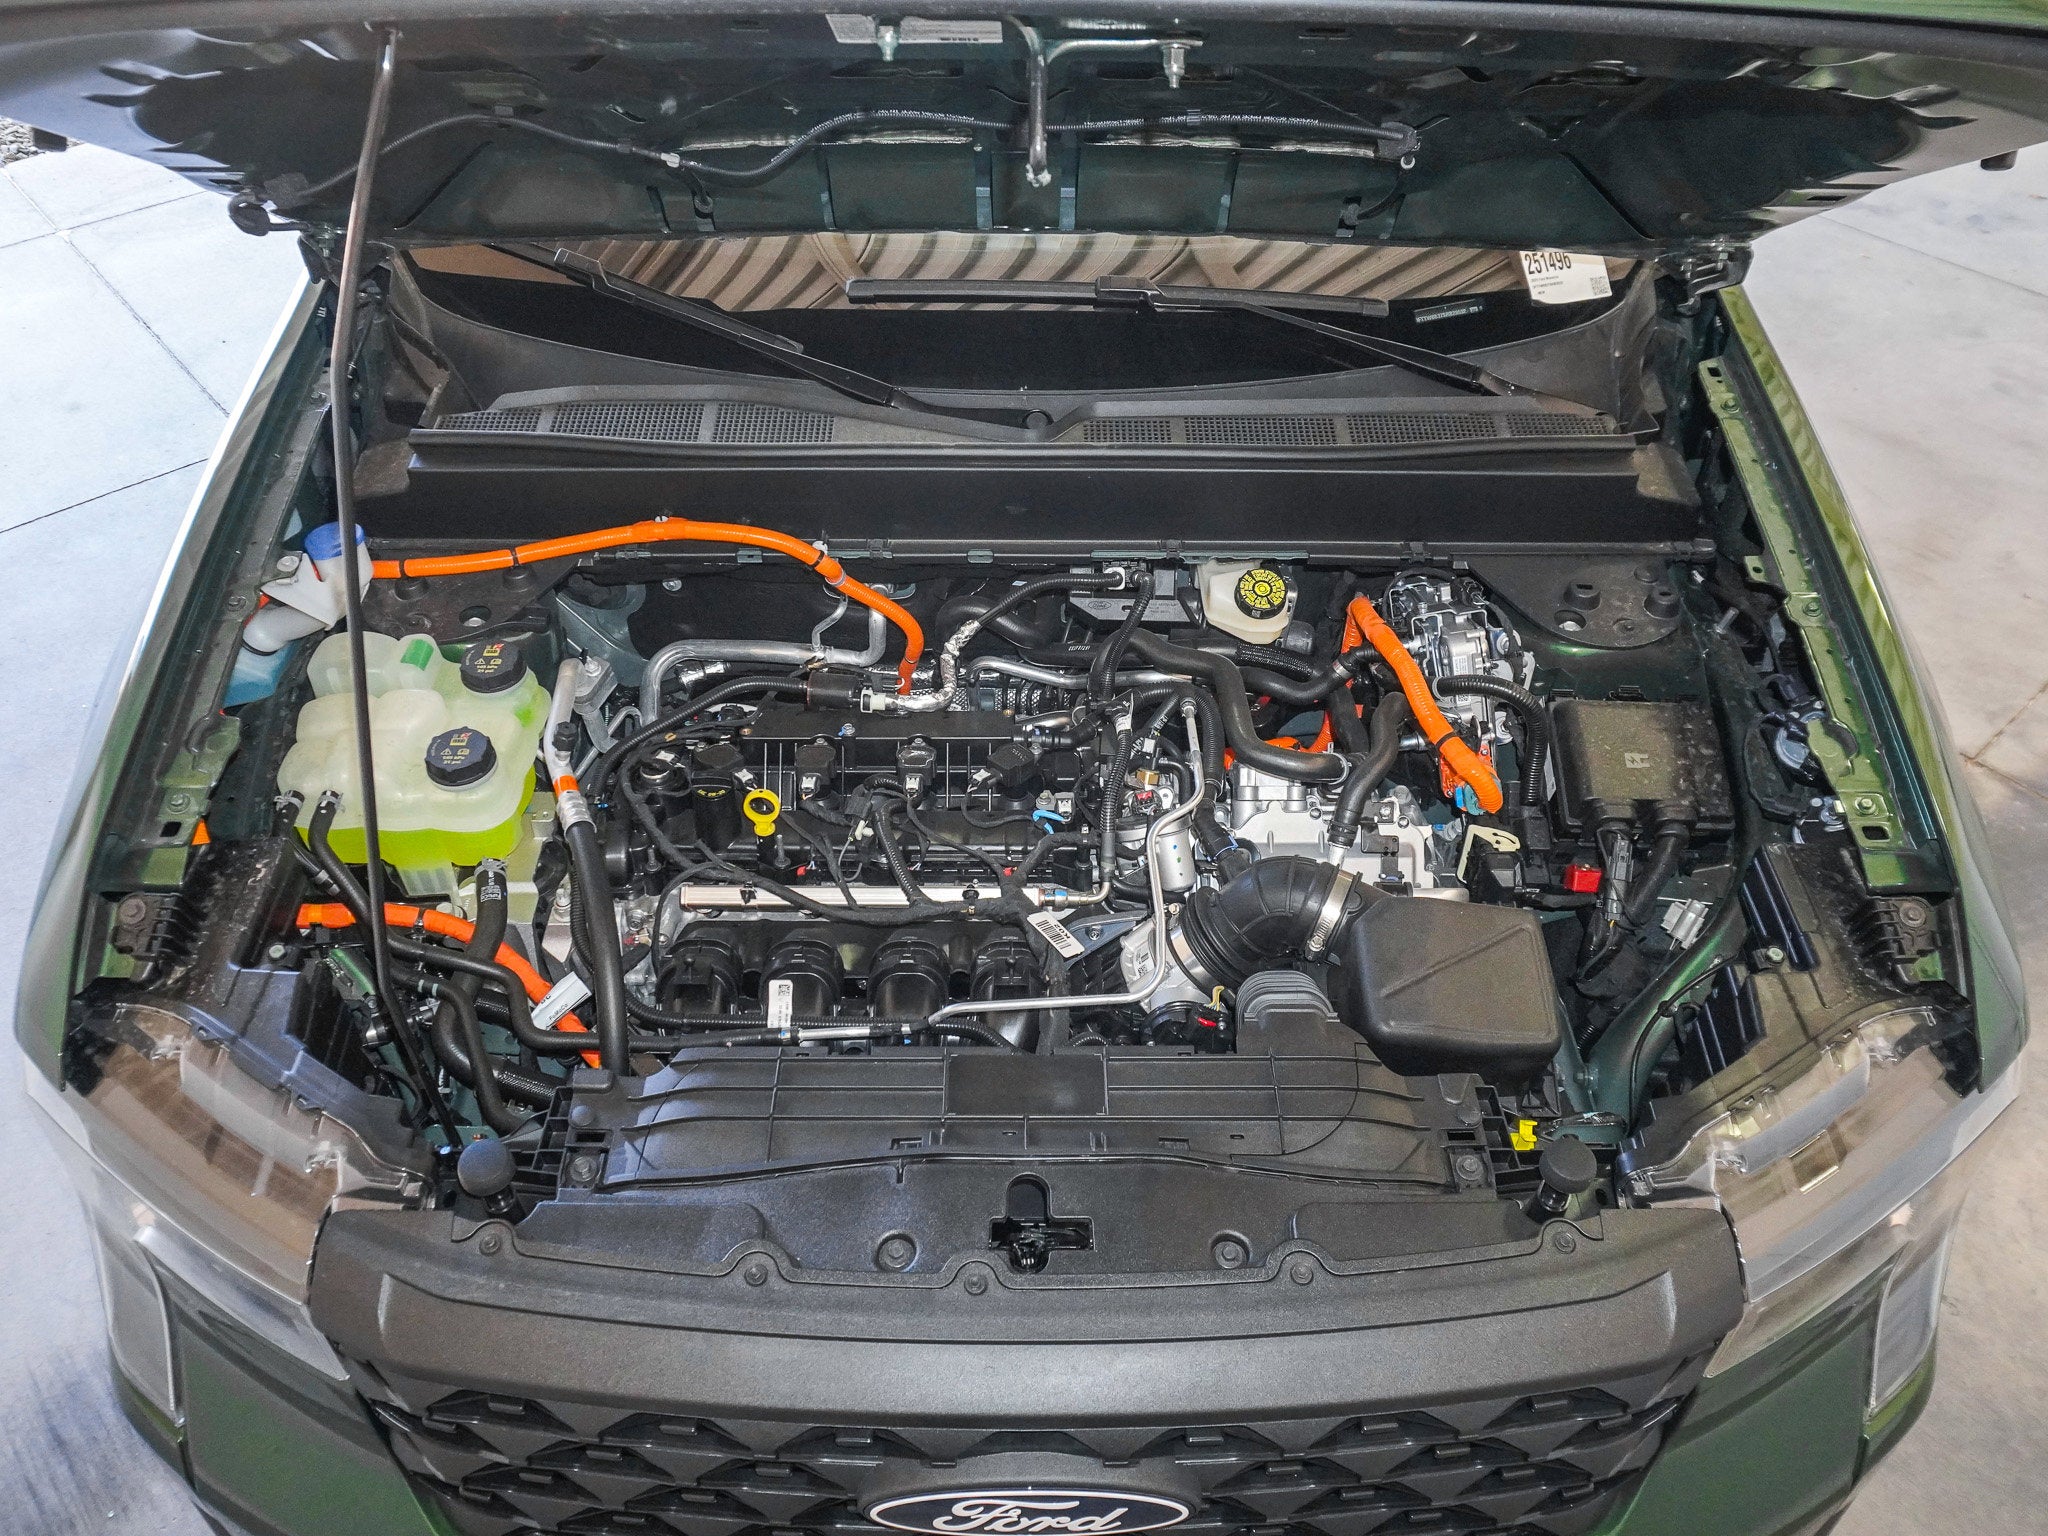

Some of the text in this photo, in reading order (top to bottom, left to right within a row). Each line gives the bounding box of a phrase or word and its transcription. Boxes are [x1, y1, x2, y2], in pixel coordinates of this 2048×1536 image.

[1524, 251, 1571, 275] 251496
[1053, 923, 1071, 939] K02
[932, 1499, 1129, 1532] Ford
